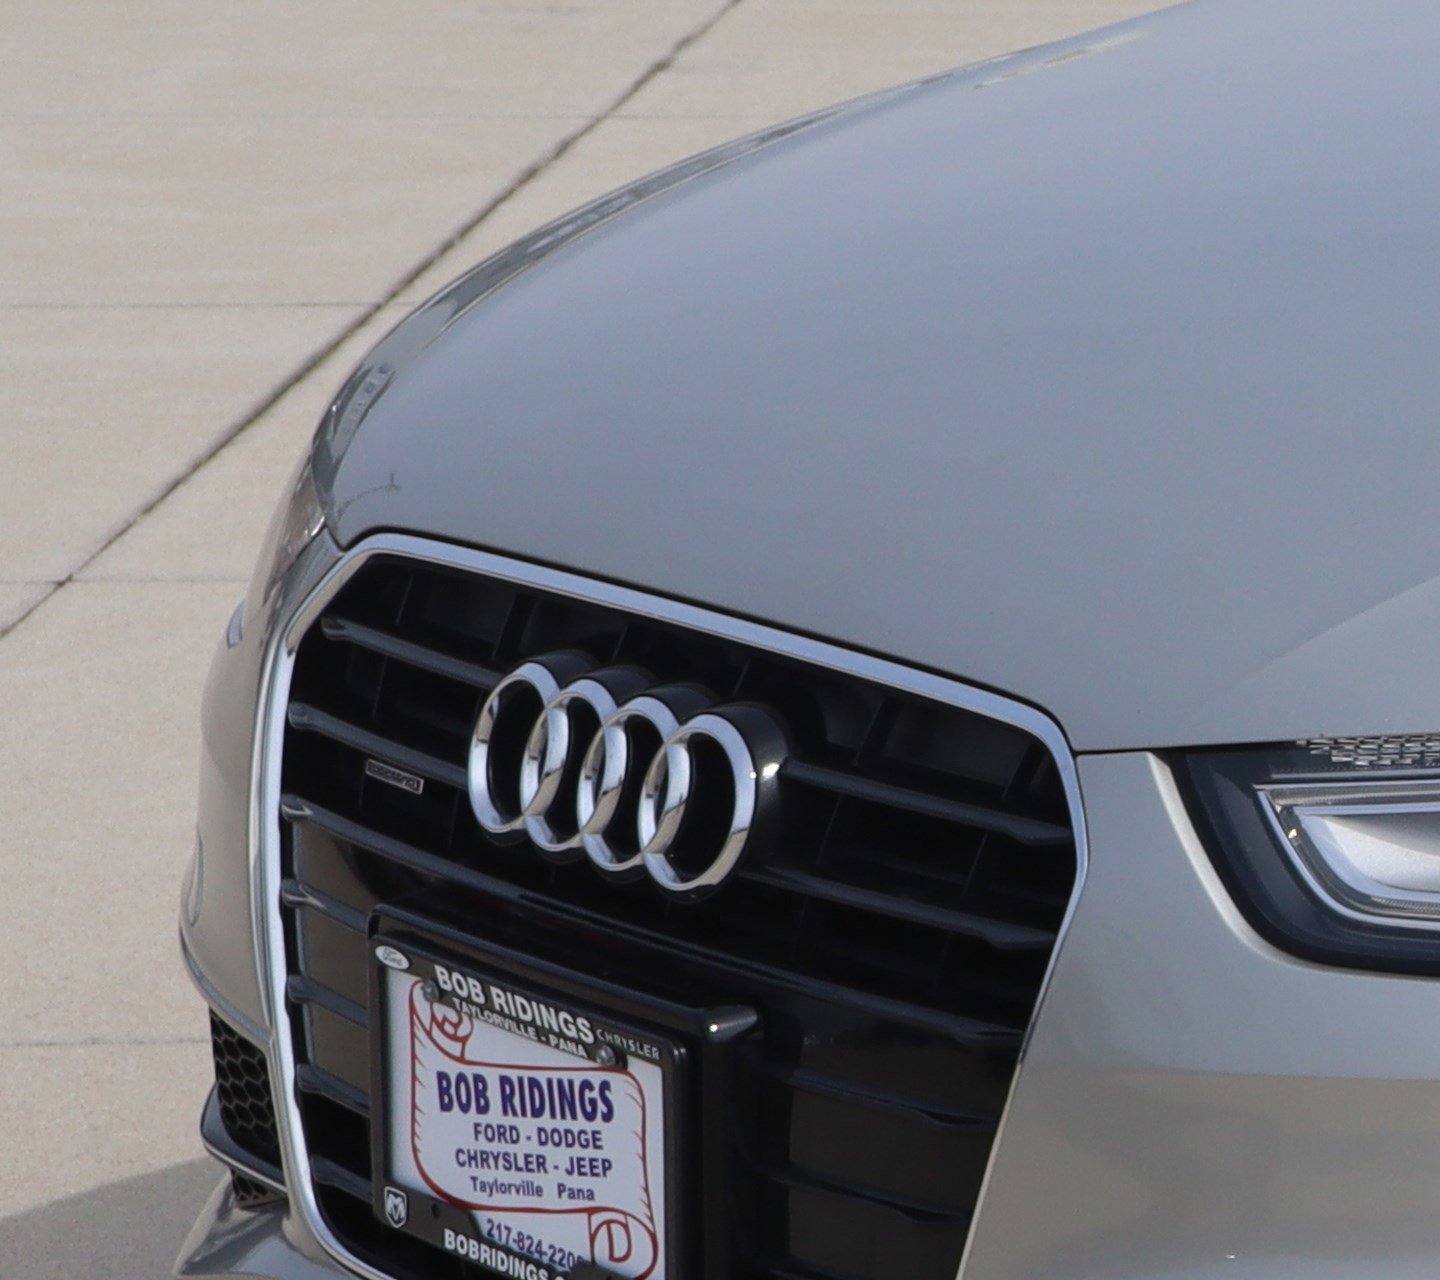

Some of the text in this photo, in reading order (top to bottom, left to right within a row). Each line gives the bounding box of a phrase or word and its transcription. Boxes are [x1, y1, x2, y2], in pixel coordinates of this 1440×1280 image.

[434, 964, 595, 1044] BOB RIDINGS
[452, 998, 537, 1041] TAYLORVILLE
[549, 1035, 588, 1059] PANA
[596, 1028, 661, 1061] CHRYSLER
[436, 1070, 614, 1123] BOB RIDINGS
[473, 1123, 520, 1145] FORD
[537, 1127, 604, 1150] DODGE
[455, 1148, 549, 1175] CHRYSLER
[564, 1156, 613, 1179] JEEP
[470, 1176, 595, 1201] Taylorville Pana
